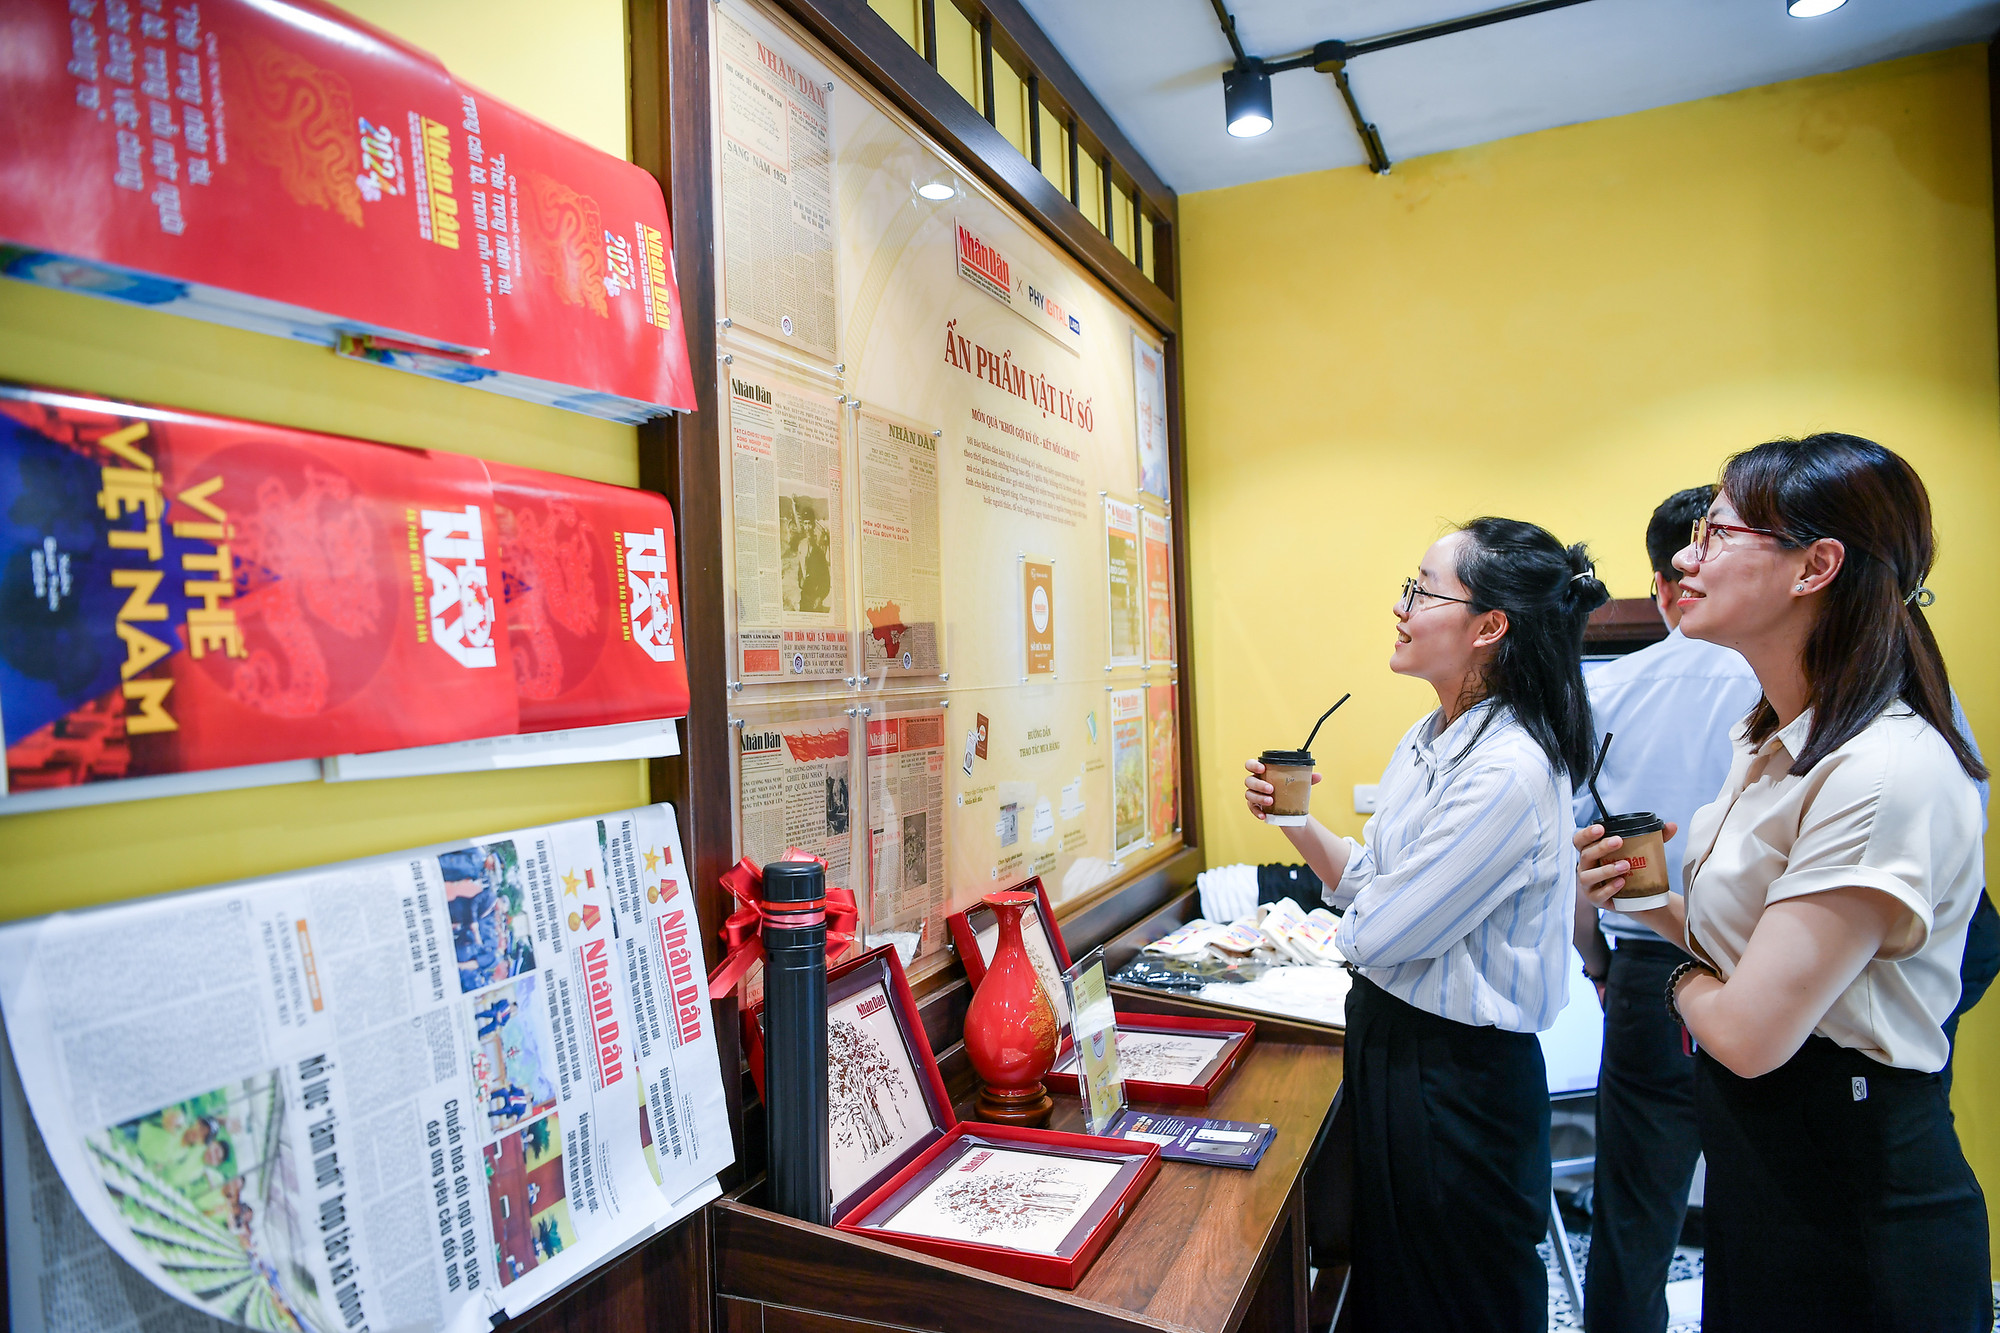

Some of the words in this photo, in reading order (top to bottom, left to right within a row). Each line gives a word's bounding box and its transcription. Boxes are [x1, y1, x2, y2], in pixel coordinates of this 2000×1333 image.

[757, 42, 795, 86] NHÂN
[798, 73, 824, 108] DÂN
[359, 117, 398, 196] 2024
[425, 119, 453, 193] Nhân
[727, 140, 749, 161] SANG
[431, 192, 459, 249] Dân
[604, 231, 629, 289] 2024
[646, 226, 666, 285] Nhân
[959, 226, 988, 271] Nhân
[989, 248, 1009, 285] Dân
[652, 285, 670, 330] Dân
[732, 378, 754, 399] Nhân
[755, 386, 771, 404] Dân
[945, 319, 971, 373] ẤN
[976, 345, 1026, 400] PHẨM
[1030, 373, 1056, 419] VẬT
[1059, 389, 1074, 423] LÝ
[1077, 397, 1094, 432] SỐ
[971, 408, 985, 423] MÓN
[986, 415, 998, 429] QUÀ
[888, 424, 915, 444] NHÂN
[917, 434, 935, 451] DÂN
[96, 421, 166, 561] VIỆT
[422, 511, 467, 665] NAY
[616, 567, 626, 583] CỦA
[624, 533, 659, 660] NAY
[110, 570, 180, 735] NAM
[740, 732, 763, 751] Nhân
[764, 732, 780, 749] Dân
[663, 911, 691, 984] Nhân
[585, 939, 612, 1020] Nhân
[676, 985, 700, 1042] Dân
[856, 1000, 874, 1016] Nhân
[872, 994, 886, 1009] Dân
[598, 1022, 622, 1085] Dân
[297, 1078, 330, 1110] lực
[426, 1120, 440, 1147] đáp
[444, 1099, 461, 1144] Chuẩn
[430, 1149, 444, 1177] ứng
[450, 1145, 464, 1173] hóa
[433, 1178, 448, 1206] yêu
[454, 1175, 469, 1198] đội
[314, 1192, 347, 1231] hợp
[438, 1208, 453, 1236] cầu
[457, 1200, 471, 1227] ngũ
[324, 1227, 354, 1261] tác
[442, 1237, 457, 1262] đổi
[461, 1229, 475, 1257] nhà
[446, 1263, 460, 1292] mới
[464, 1258, 479, 1290] giáo
